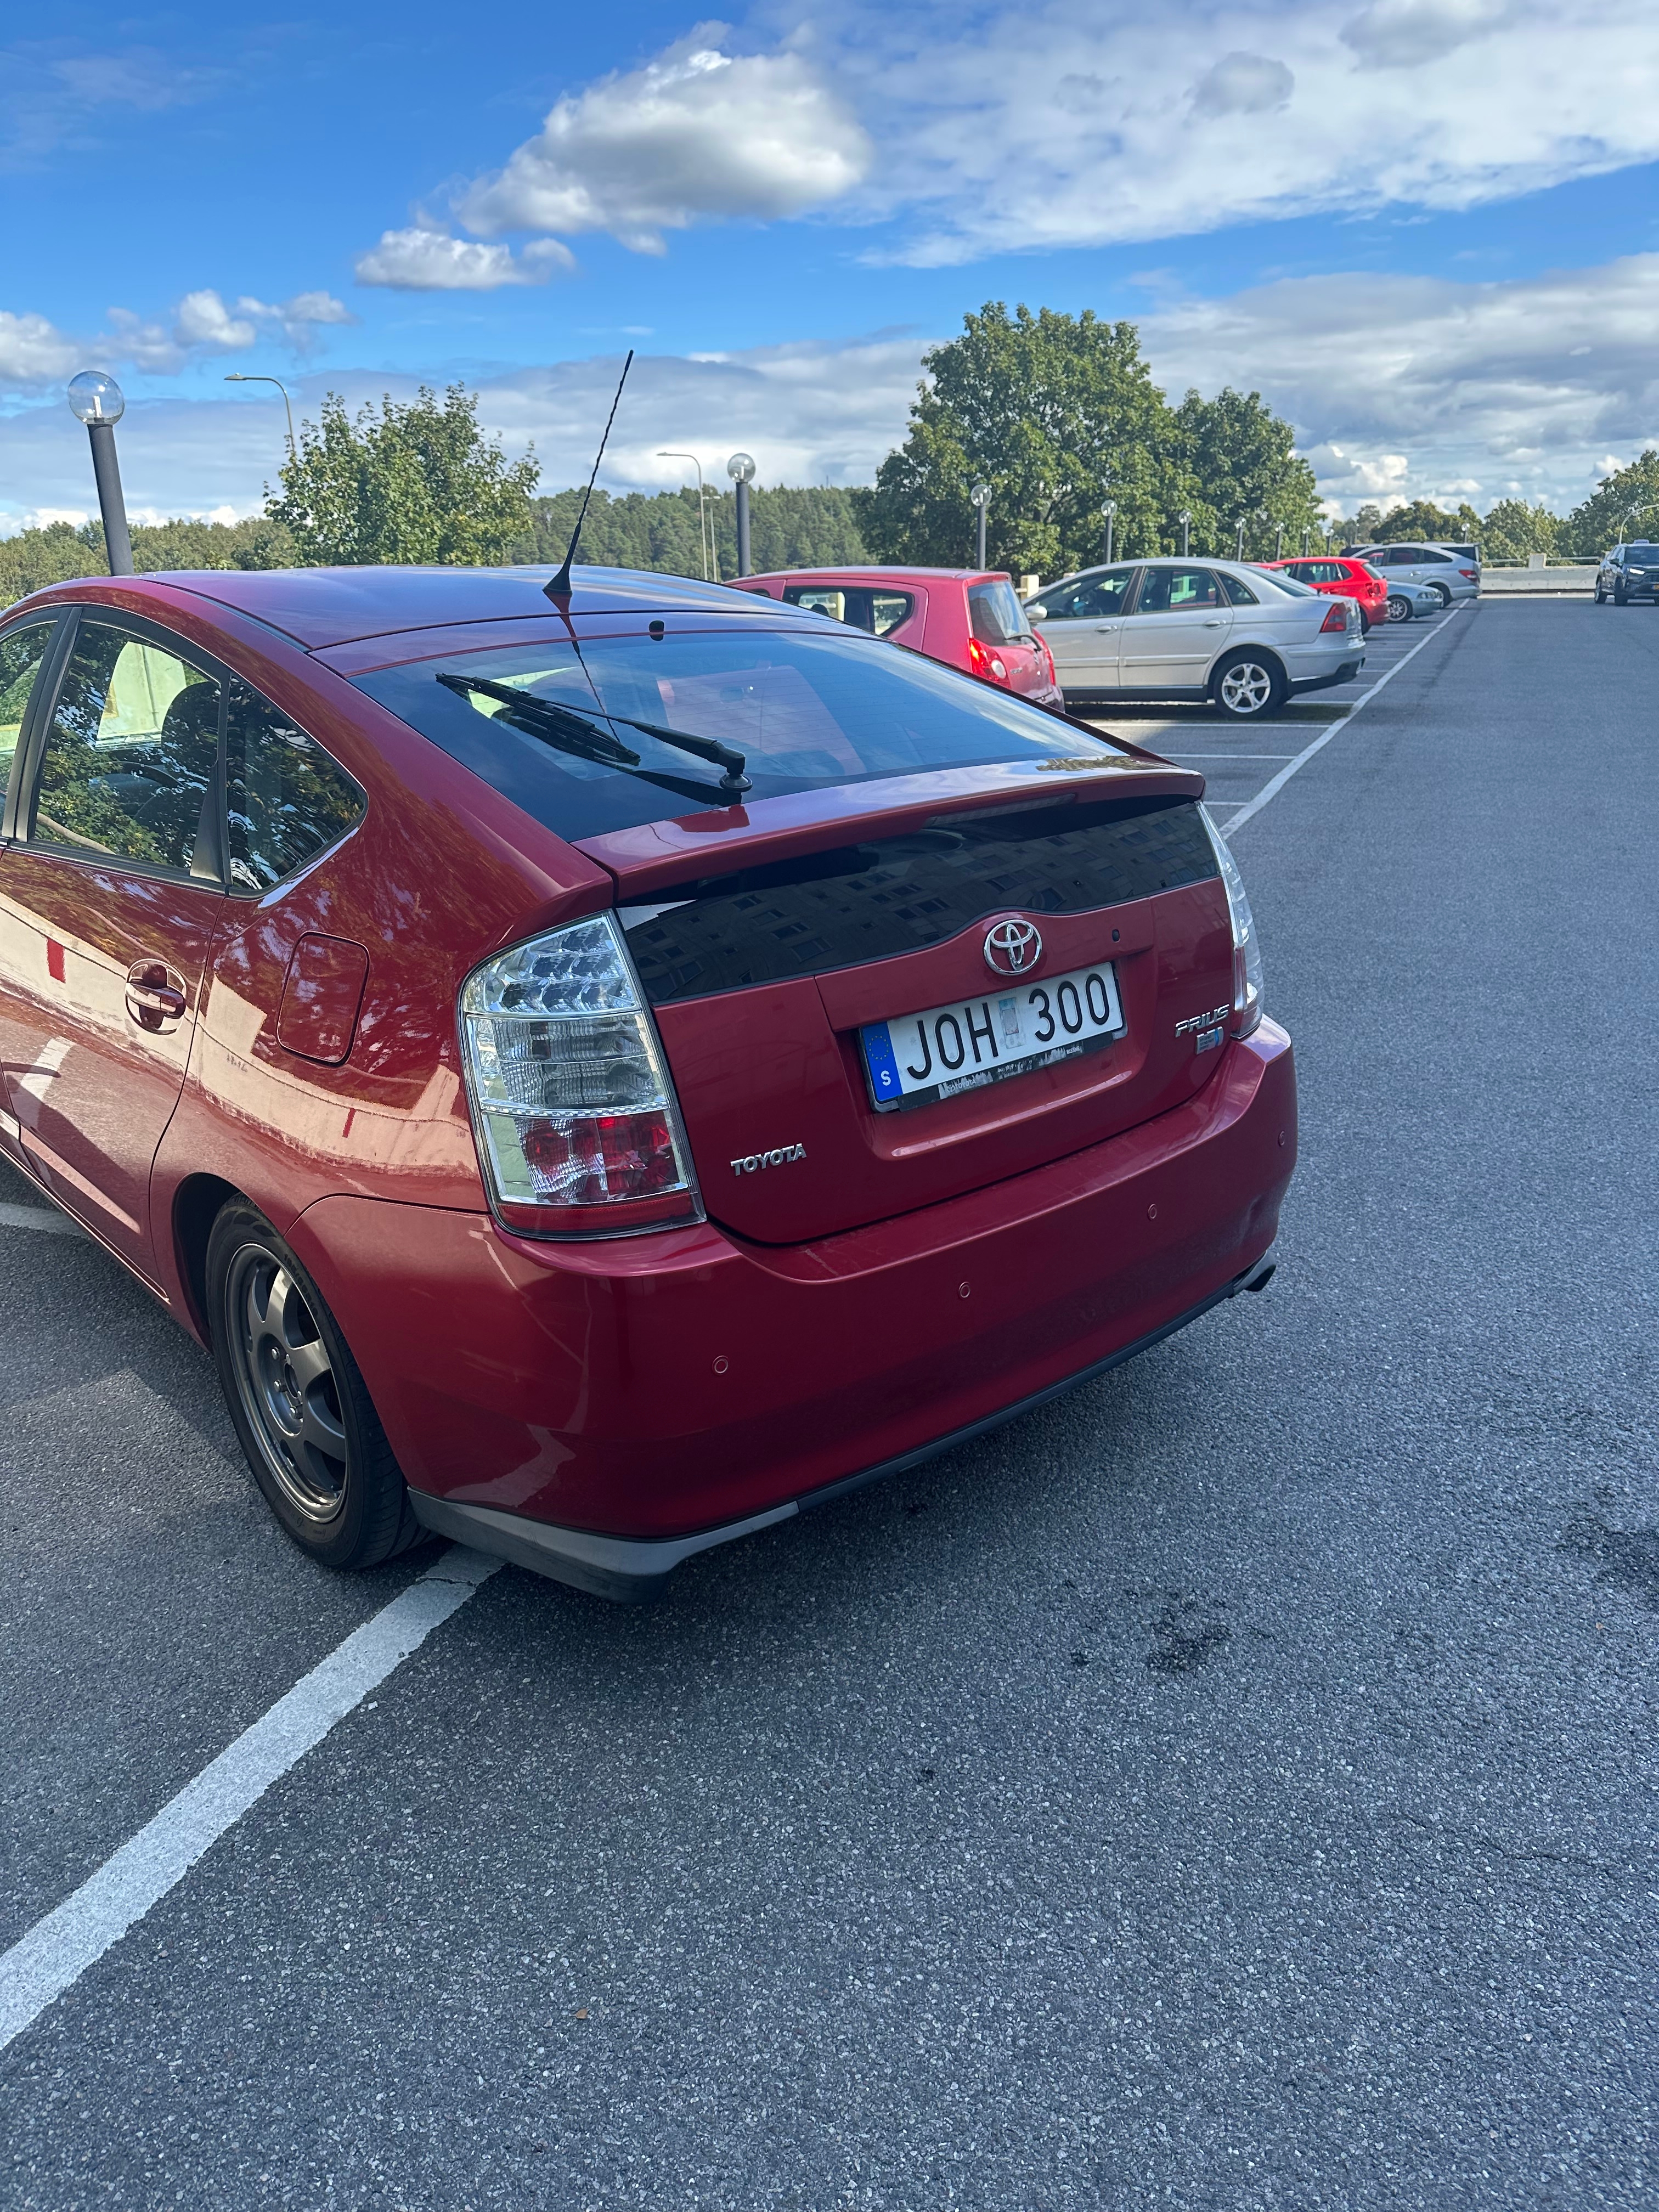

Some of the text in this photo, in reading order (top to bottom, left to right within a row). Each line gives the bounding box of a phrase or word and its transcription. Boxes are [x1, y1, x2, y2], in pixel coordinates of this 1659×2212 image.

[907, 973, 1110, 1080] JOH 300
[1175, 1004, 1229, 1037] PRIUS
[881, 1070, 891, 1086] S
[956, 1079, 977, 1090] TOYOTA
[730, 1143, 807, 1176] TOYOTA
